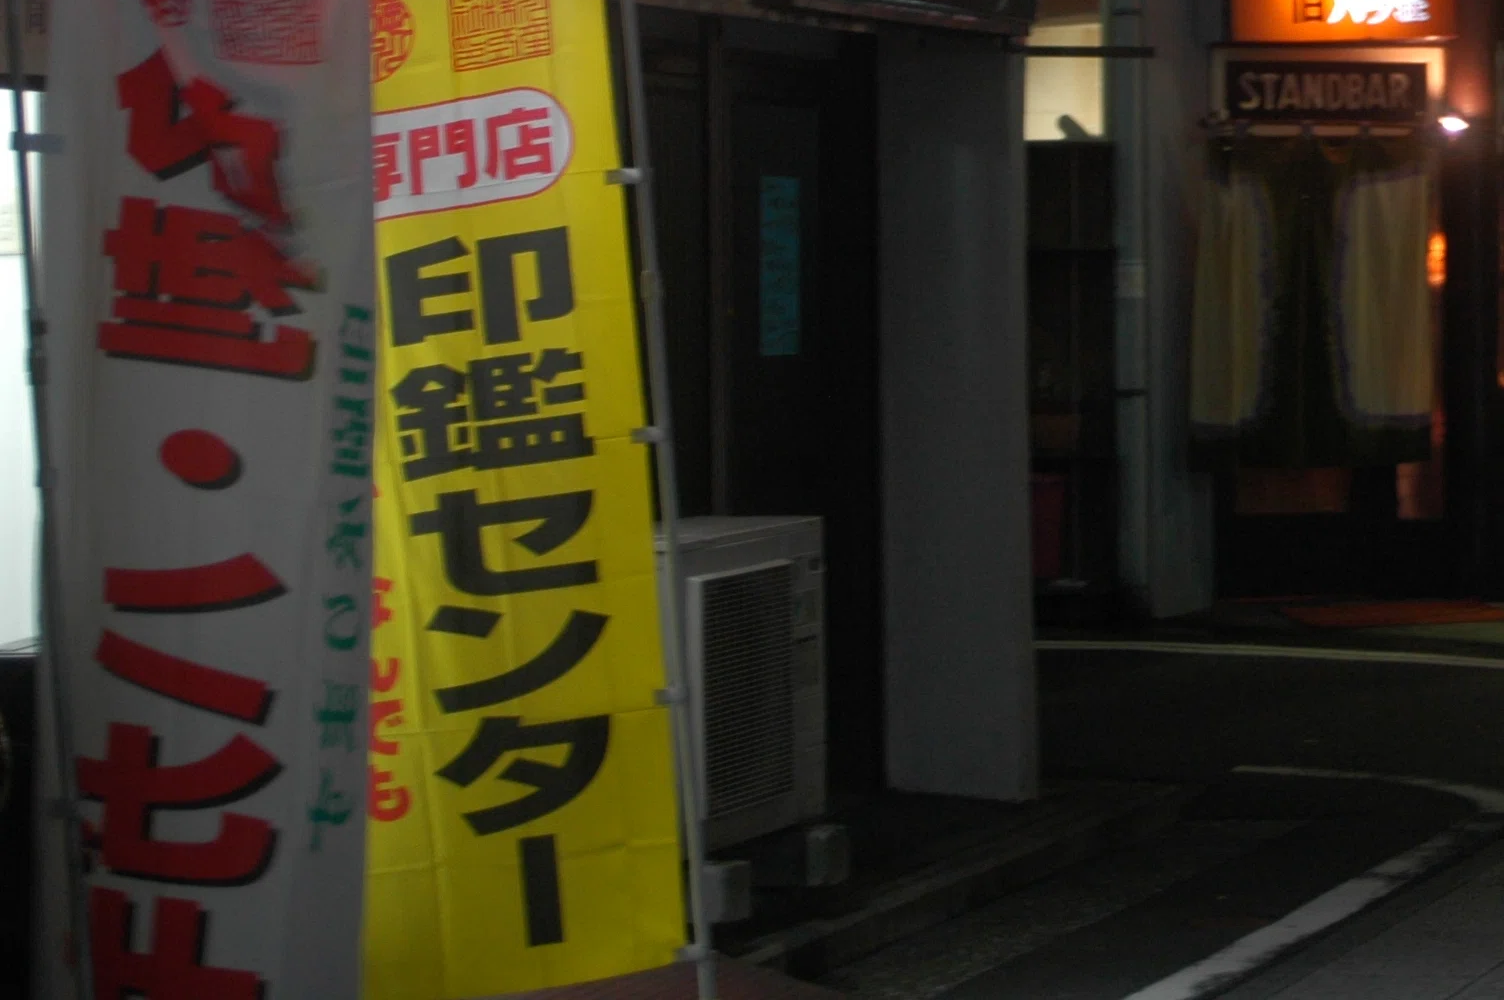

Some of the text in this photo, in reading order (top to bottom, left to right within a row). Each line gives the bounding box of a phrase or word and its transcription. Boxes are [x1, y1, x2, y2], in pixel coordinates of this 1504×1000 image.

[384, 225, 614, 949] 印鑑センター
